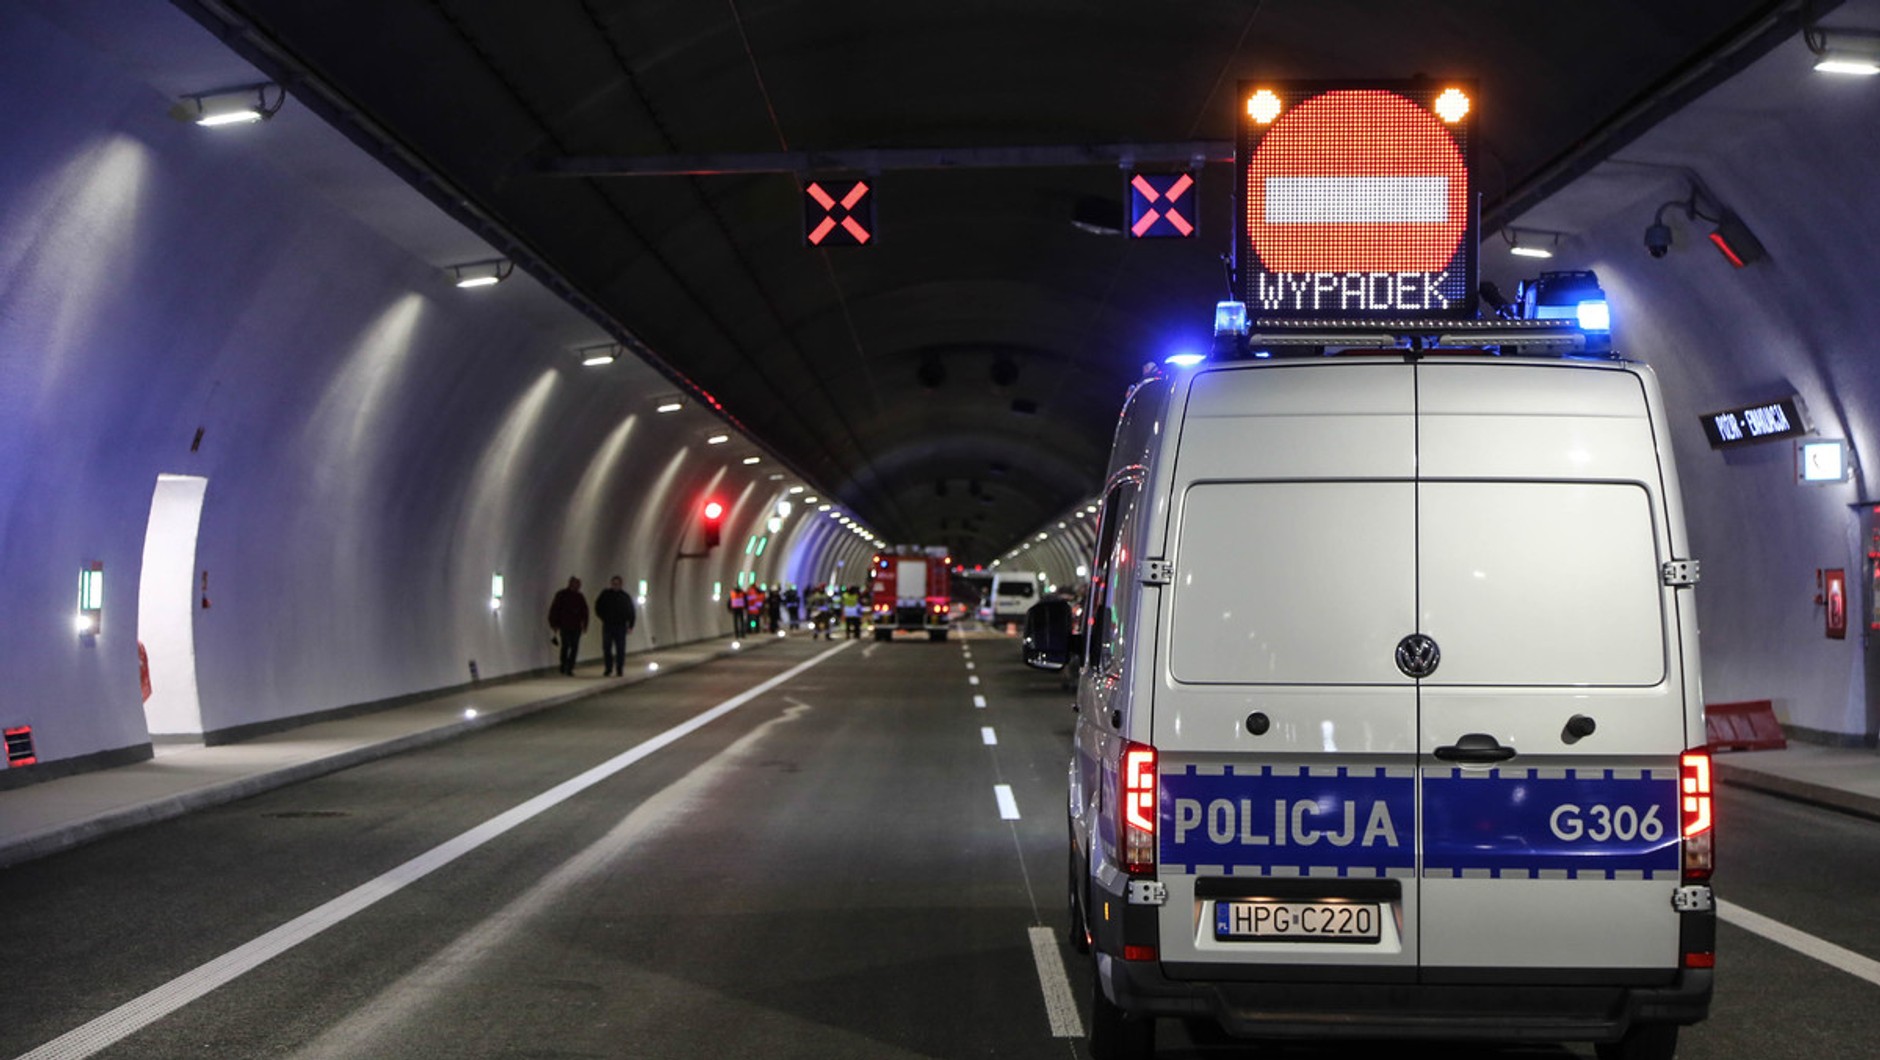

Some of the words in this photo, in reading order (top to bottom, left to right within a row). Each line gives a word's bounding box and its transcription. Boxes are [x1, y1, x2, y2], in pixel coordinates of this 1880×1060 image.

[1259, 272, 1449, 310] WYPADEK
[1174, 798, 1399, 847] POLICJA
[1549, 803, 1664, 842] G306
[1235, 906, 1290, 933] HPG
[1301, 907, 1371, 934] C220
